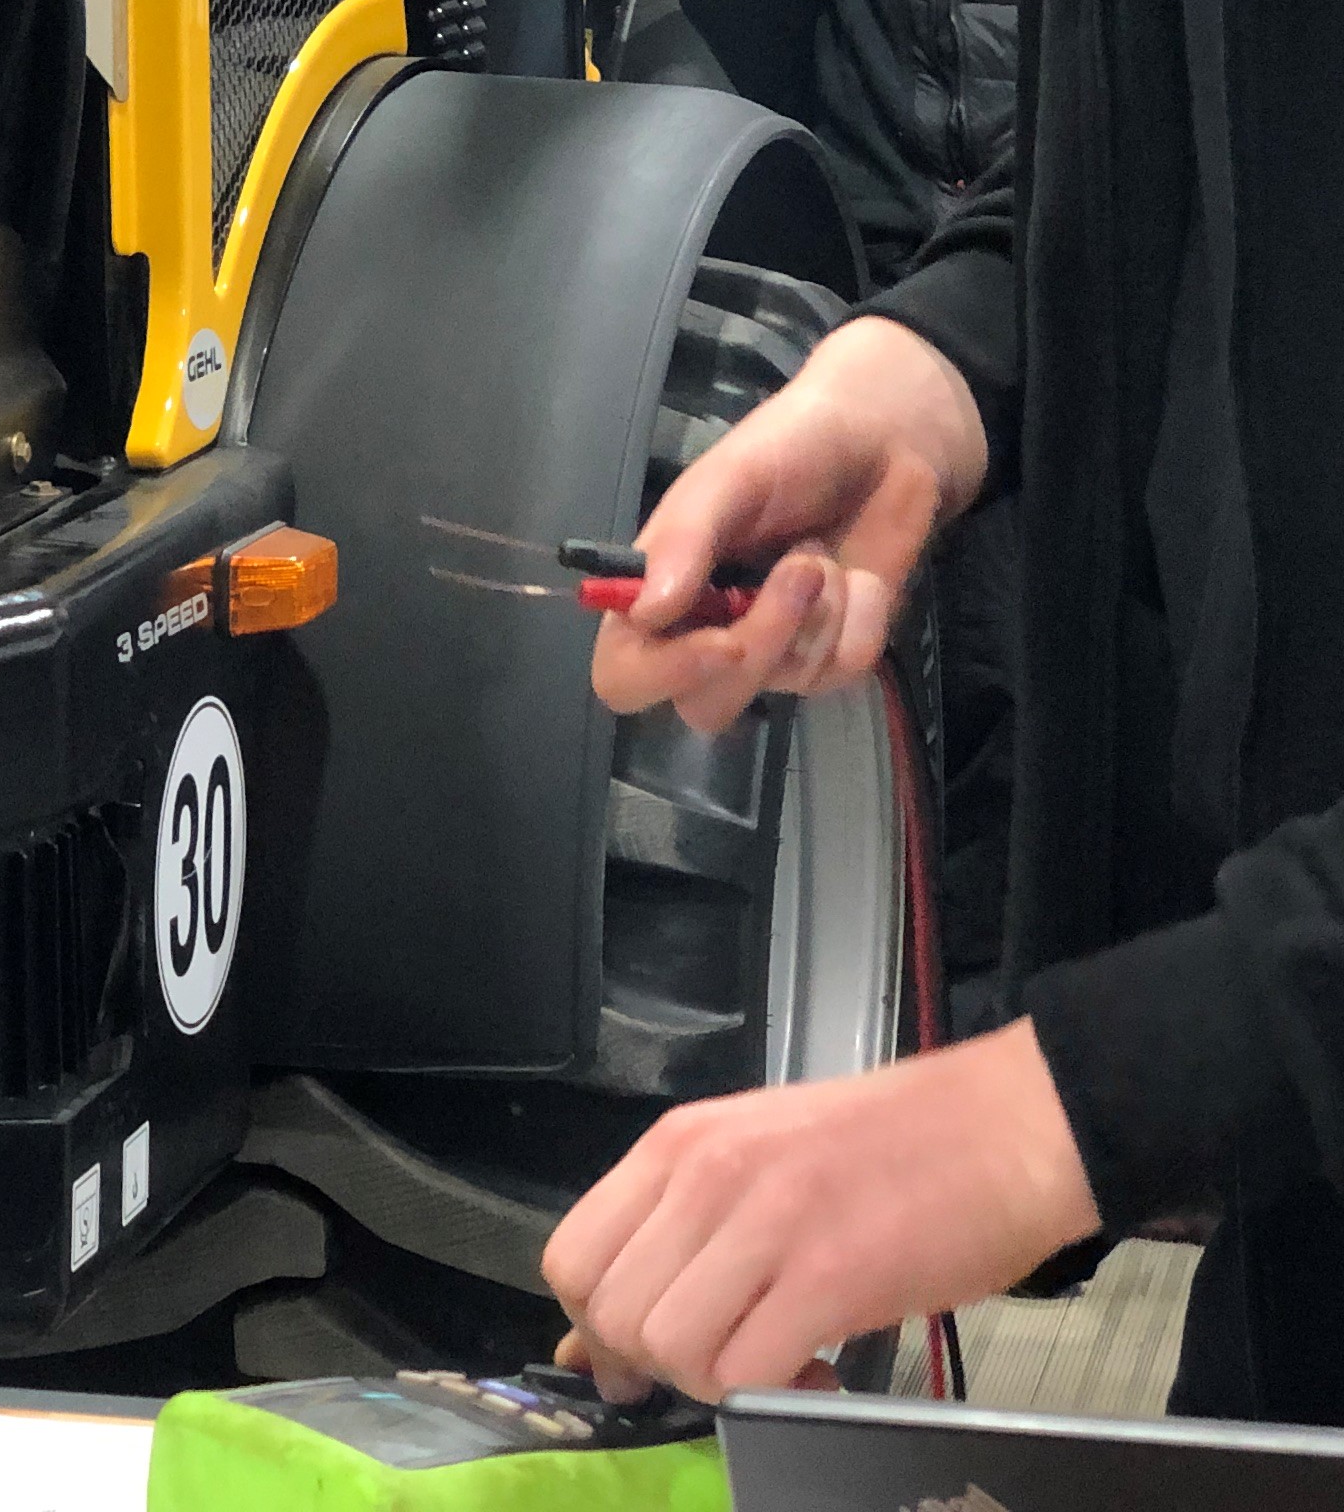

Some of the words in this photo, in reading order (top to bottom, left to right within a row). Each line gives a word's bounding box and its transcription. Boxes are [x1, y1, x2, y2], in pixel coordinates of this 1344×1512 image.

[188, 346, 222, 382] GEHL
[117, 631, 133, 663] 3
[137, 592, 208, 652] SPEED
[169, 754, 232, 977] 30
